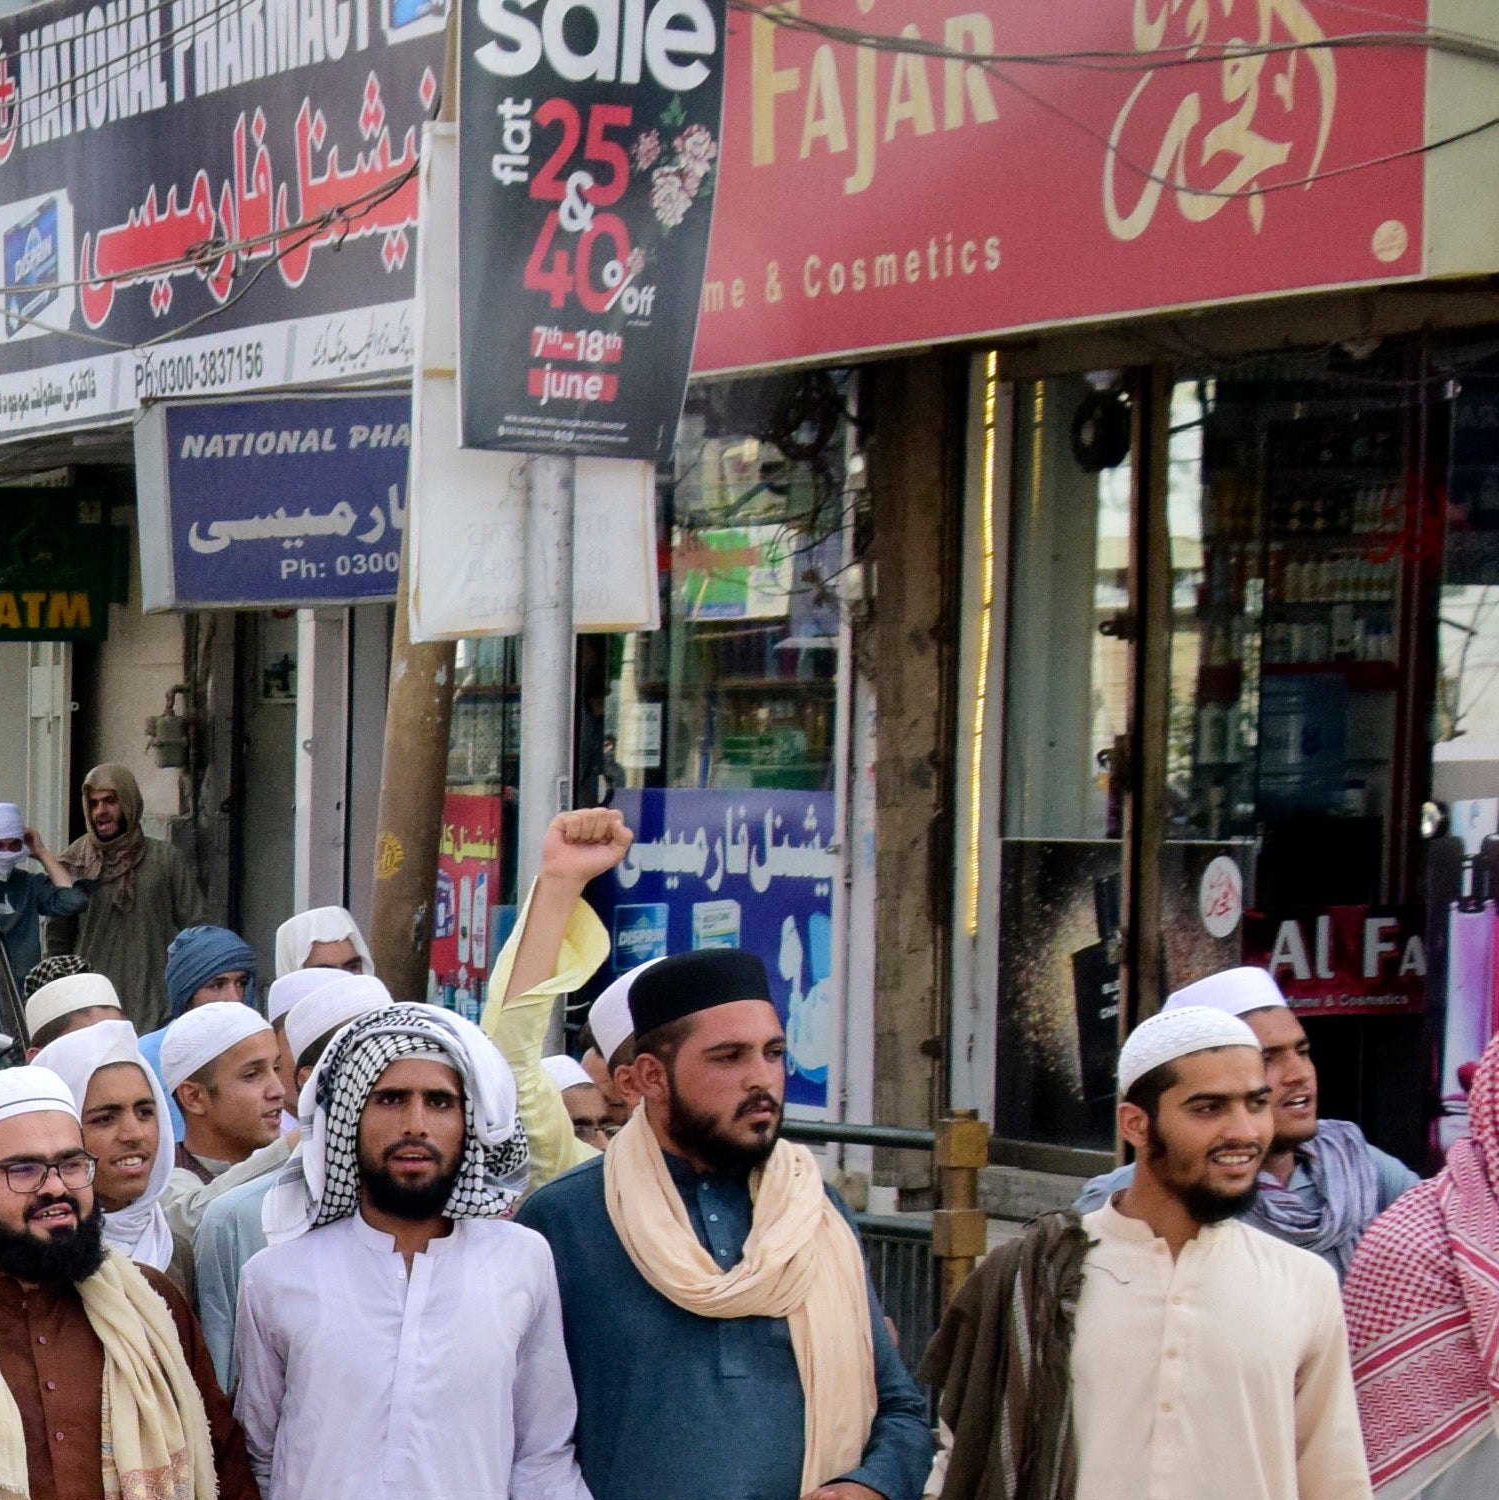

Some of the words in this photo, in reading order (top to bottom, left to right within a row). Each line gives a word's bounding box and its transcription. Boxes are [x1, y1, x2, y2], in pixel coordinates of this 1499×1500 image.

[19, 0, 167, 149] NATIONAL
[474, 0, 716, 91] sale
[277, 65, 433, 288] یشنل
[491, 97, 532, 186] flat
[529, 97, 633, 206] 25
[76, 106, 275, 329] فارمیسی
[559, 170, 595, 233] &
[765, 259, 783, 304] &
[803, 233, 1001, 299] Cosmetics
[539, 363, 603, 405] june
[181, 428, 337, 459] NATIONAL
[188, 483, 407, 554] ارمیسی
[281, 558, 326, 579] Ph:
[1268, 914, 1335, 980] Al
